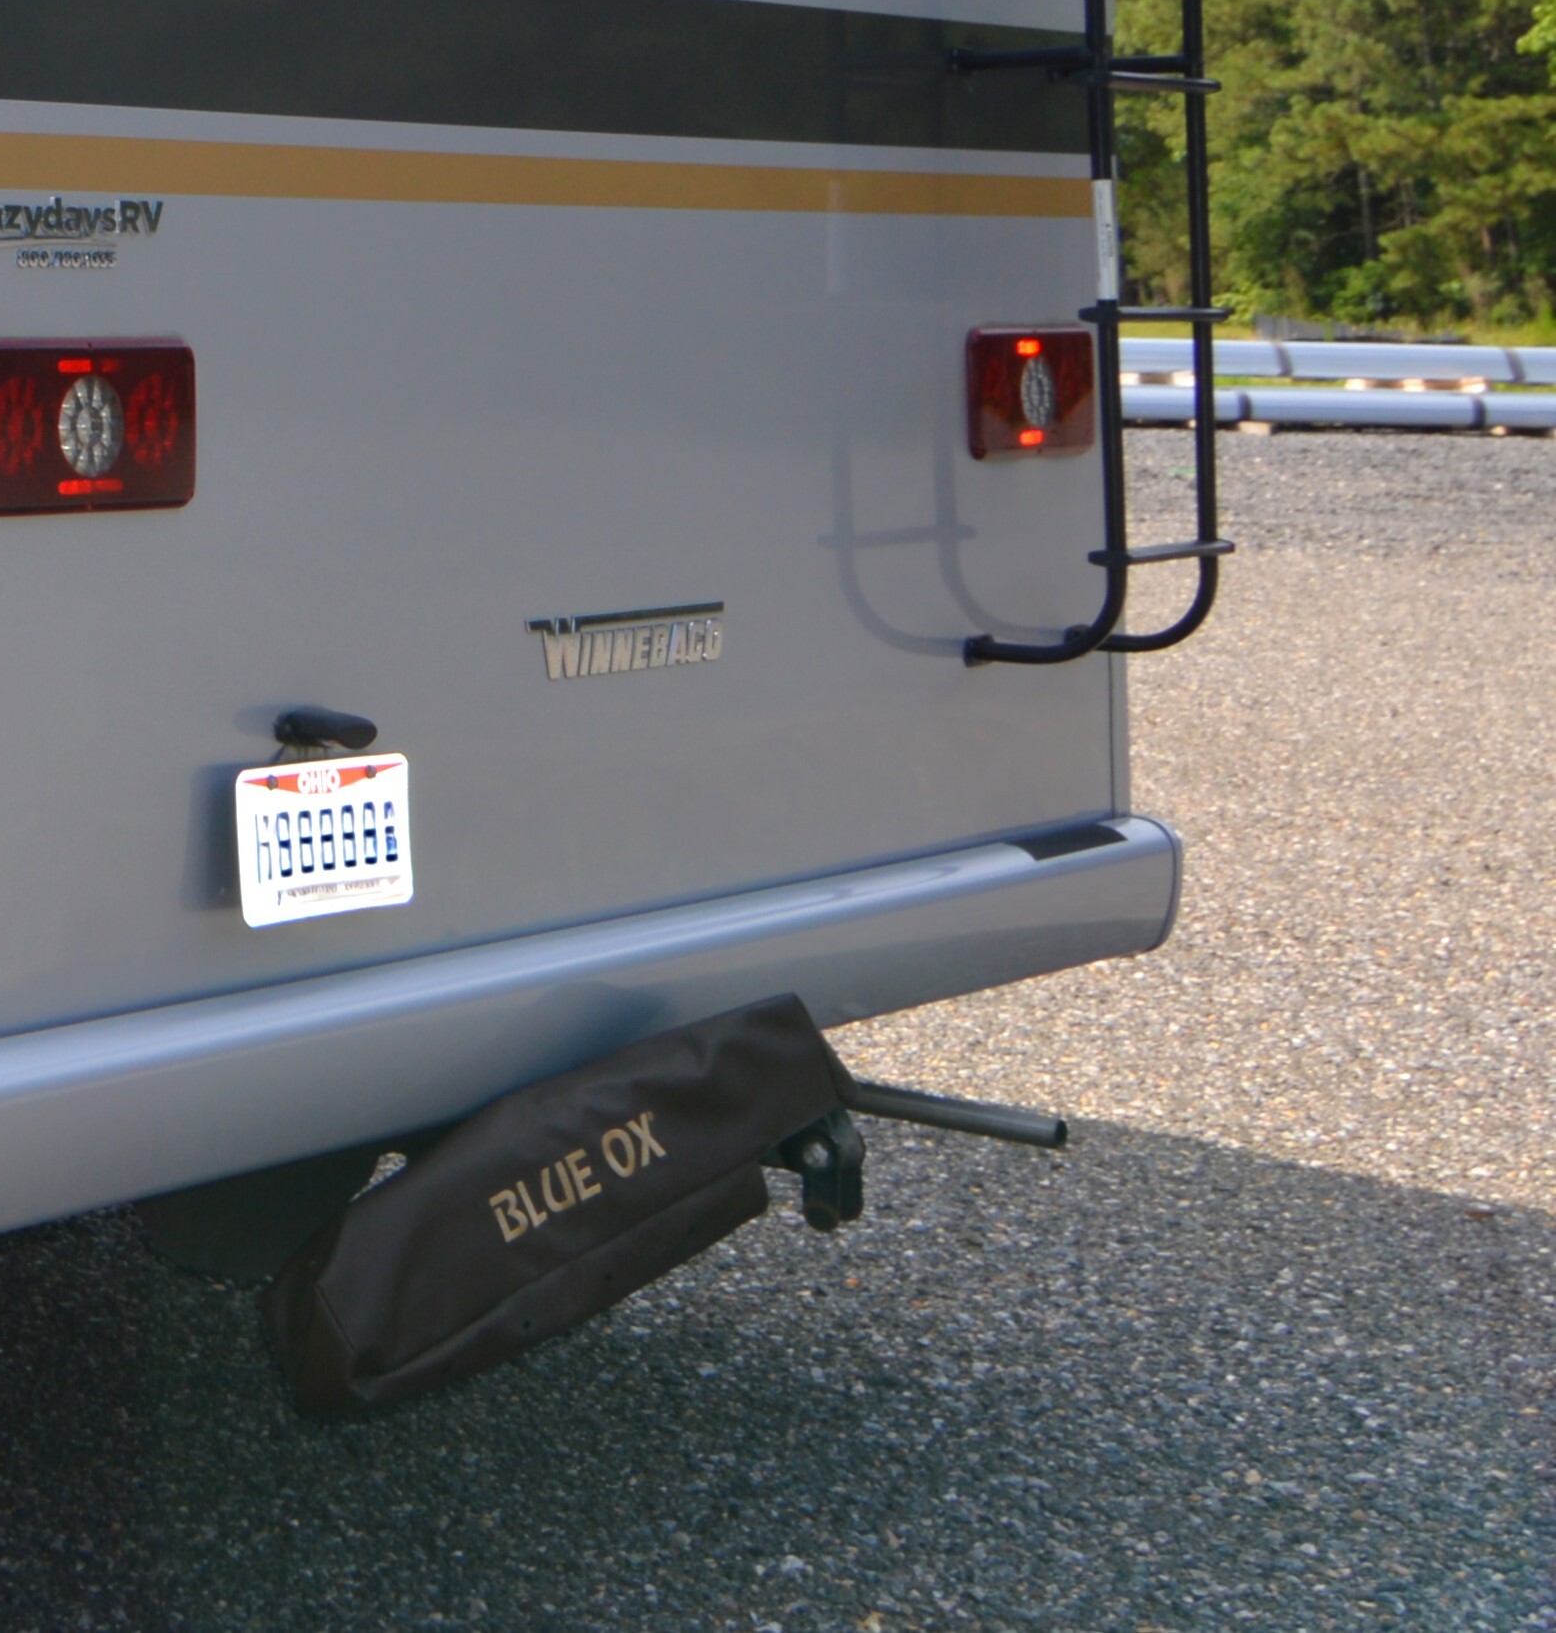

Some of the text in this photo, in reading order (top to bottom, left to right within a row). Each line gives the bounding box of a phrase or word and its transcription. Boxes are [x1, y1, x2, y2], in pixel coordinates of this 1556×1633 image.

[525, 602, 725, 681] WINNEBAGO
[297, 768, 341, 795] OHIO
[489, 1113, 667, 1243] BLUE OX
